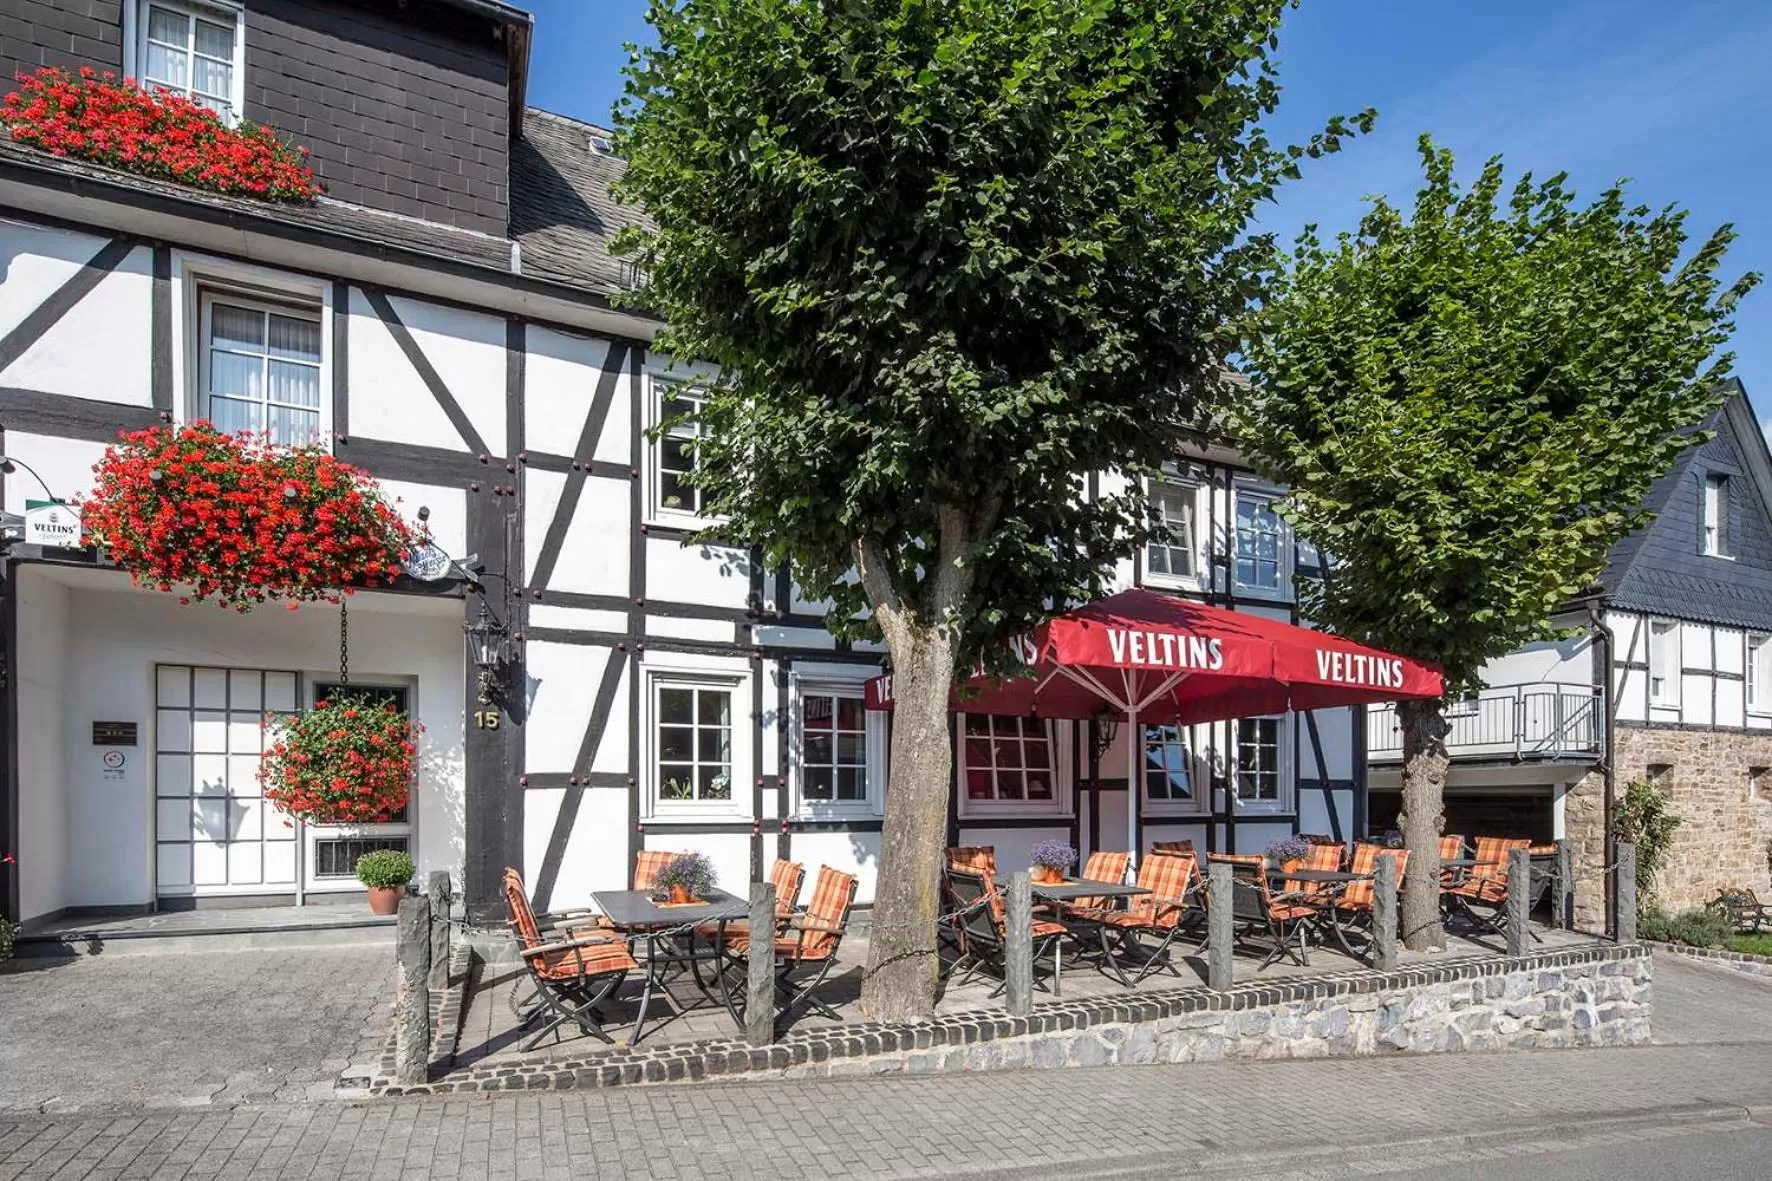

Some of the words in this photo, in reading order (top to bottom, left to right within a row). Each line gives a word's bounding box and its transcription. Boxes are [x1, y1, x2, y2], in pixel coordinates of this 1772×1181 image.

[34, 523, 74, 534] VELTINS
[1106, 628, 1223, 670] VELTINS
[1316, 649, 1404, 688] VELTINS
[474, 711, 499, 728] 15
